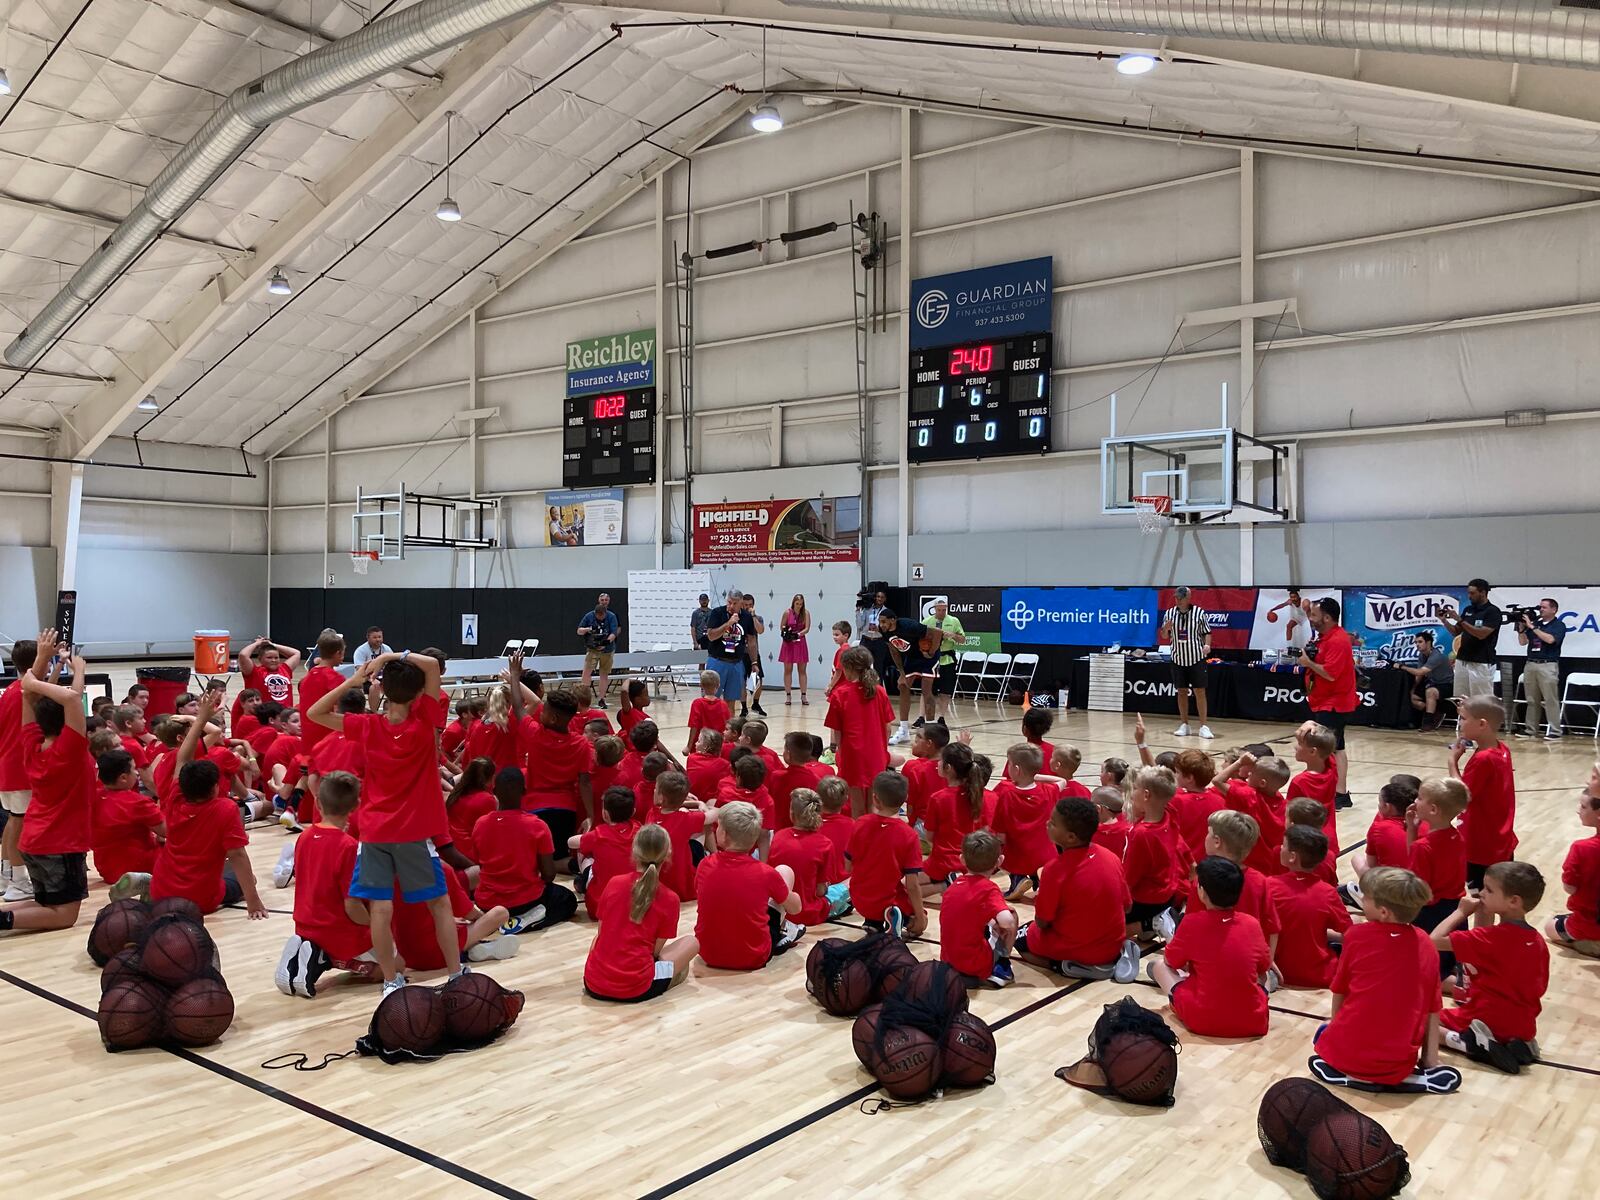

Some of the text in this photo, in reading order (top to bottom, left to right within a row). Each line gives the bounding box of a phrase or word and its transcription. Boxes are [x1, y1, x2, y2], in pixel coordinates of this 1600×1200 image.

[956, 278, 1046, 306] GUARDIAN
[956, 298, 1046, 318] FINANCIAL GROUP
[974, 312, 1025, 327] 937.433.5300
[568, 335, 654, 370] Reichley
[950, 348, 991, 375] 24.0
[1012, 358, 1040, 371] GUEST
[570, 370, 650, 388] Insurance Agency
[917, 370, 940, 382] HOME
[966, 377, 986, 386] PERIOD
[1038, 374, 1044, 398] 1
[938, 386, 944, 408] 1
[970, 388, 981, 406] 6
[595, 396, 626, 418] 10:22
[630, 410, 648, 420] GUEST
[1029, 408, 1048, 416] FOULS
[568, 417, 584, 426] HOME
[918, 418, 934, 426] FOULS
[1029, 418, 1041, 437] 0
[918, 428, 928, 446] 0
[956, 424, 966, 444] 0
[984, 422, 996, 441] 0
[700, 508, 768, 528] HIGHFIELD
[720, 534, 756, 543] 293-2531
[914, 567, 922, 578] 4
[950, 604, 991, 612] GAME ON
[1038, 608, 1150, 624] Premier Health
[466, 624, 474, 638] A
[216, 643, 225, 654] G
